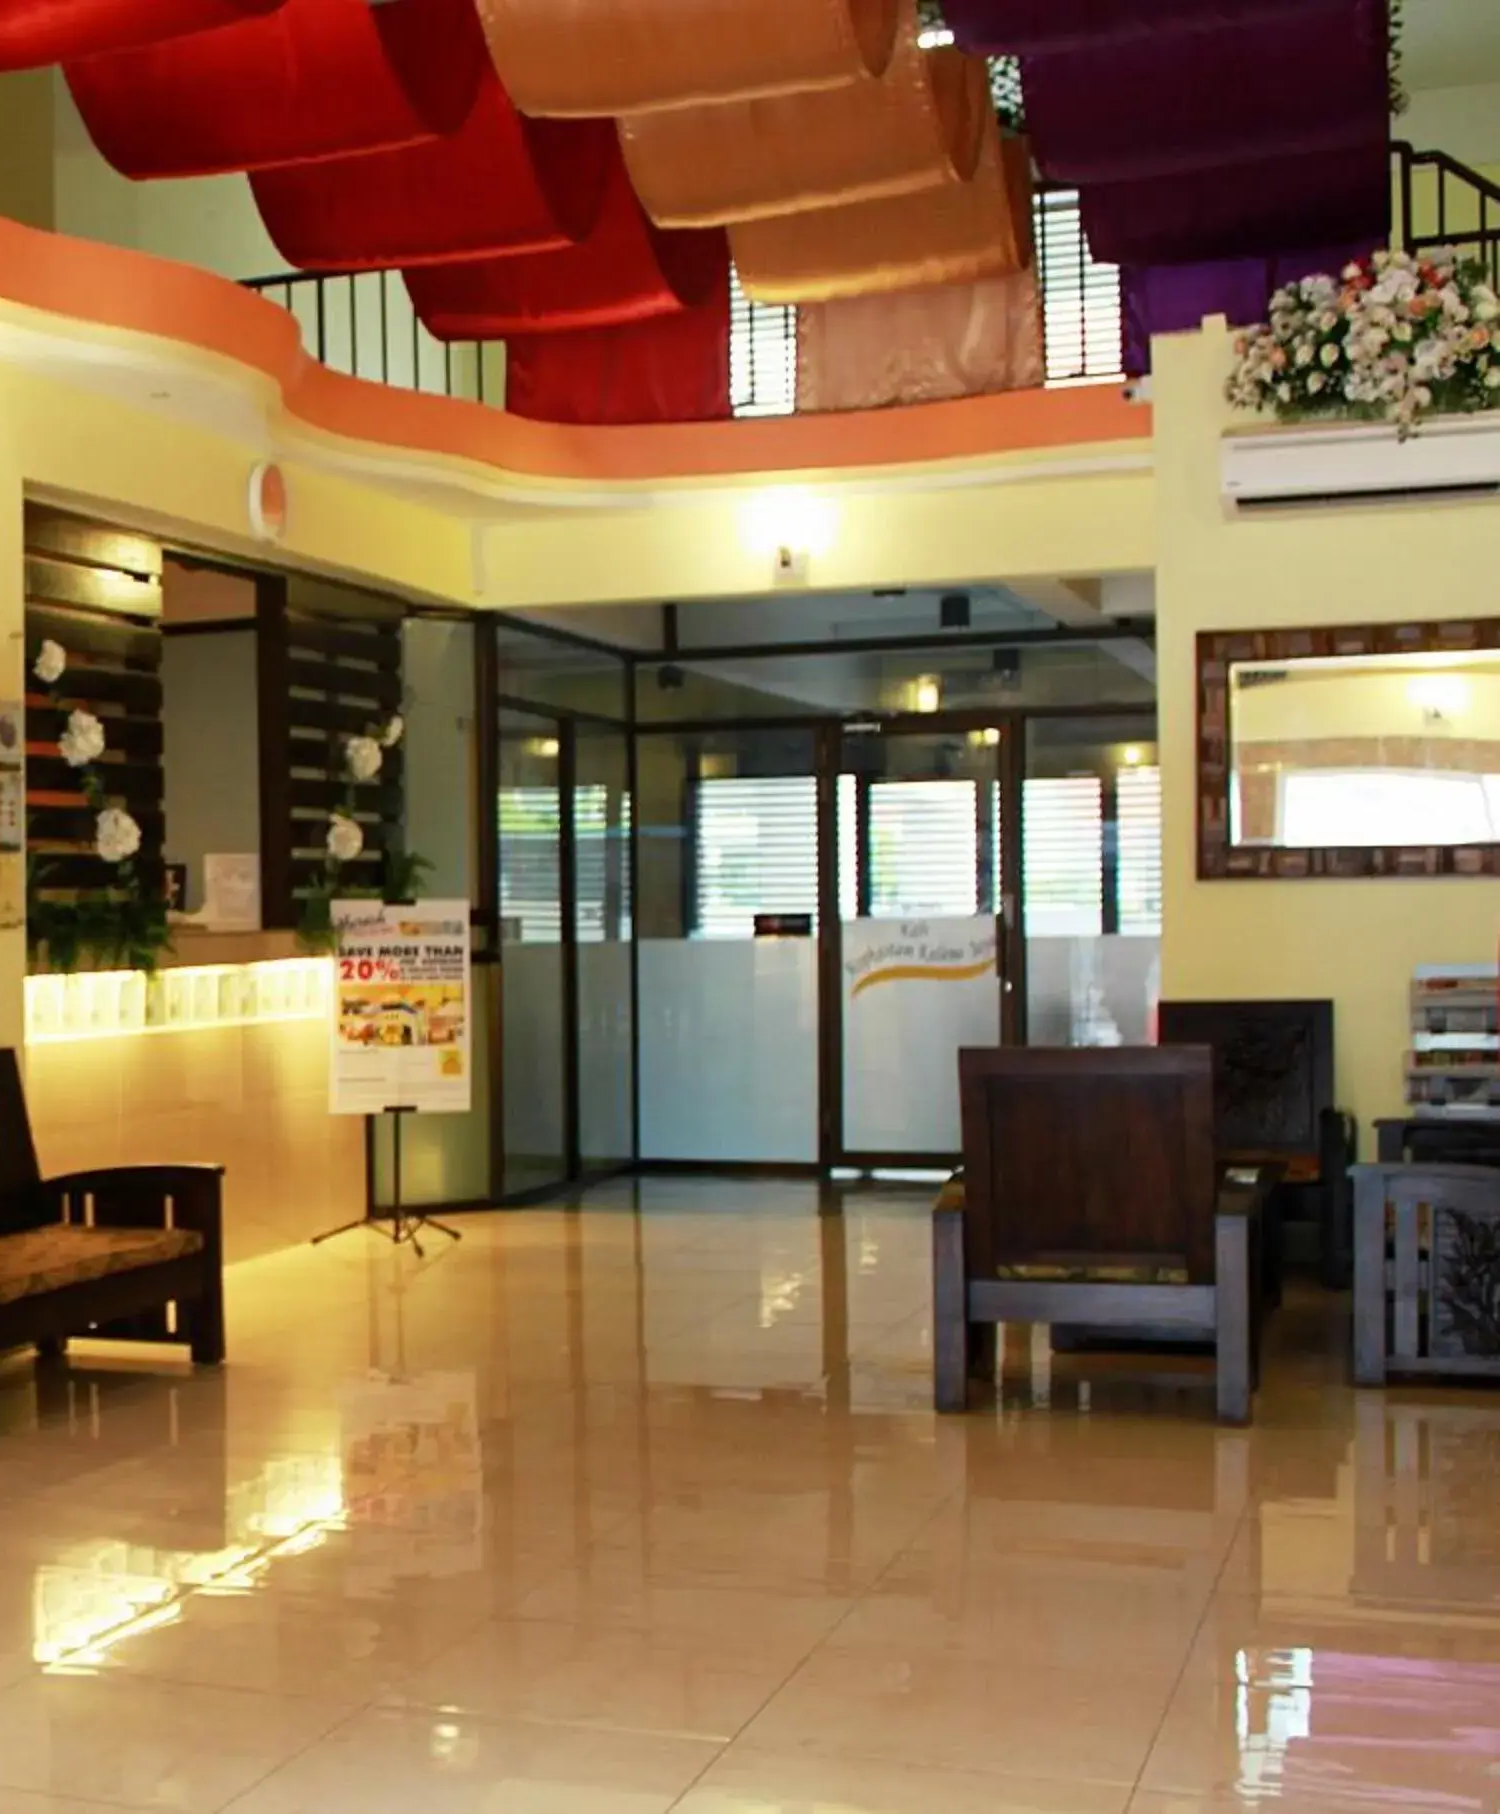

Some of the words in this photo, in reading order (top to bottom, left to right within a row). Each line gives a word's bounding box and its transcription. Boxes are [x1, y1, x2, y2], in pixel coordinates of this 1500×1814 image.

[338, 945, 373, 957] SAVE
[379, 945, 419, 957] MORE
[424, 945, 464, 957] THAN
[340, 960, 400, 981] 20%
